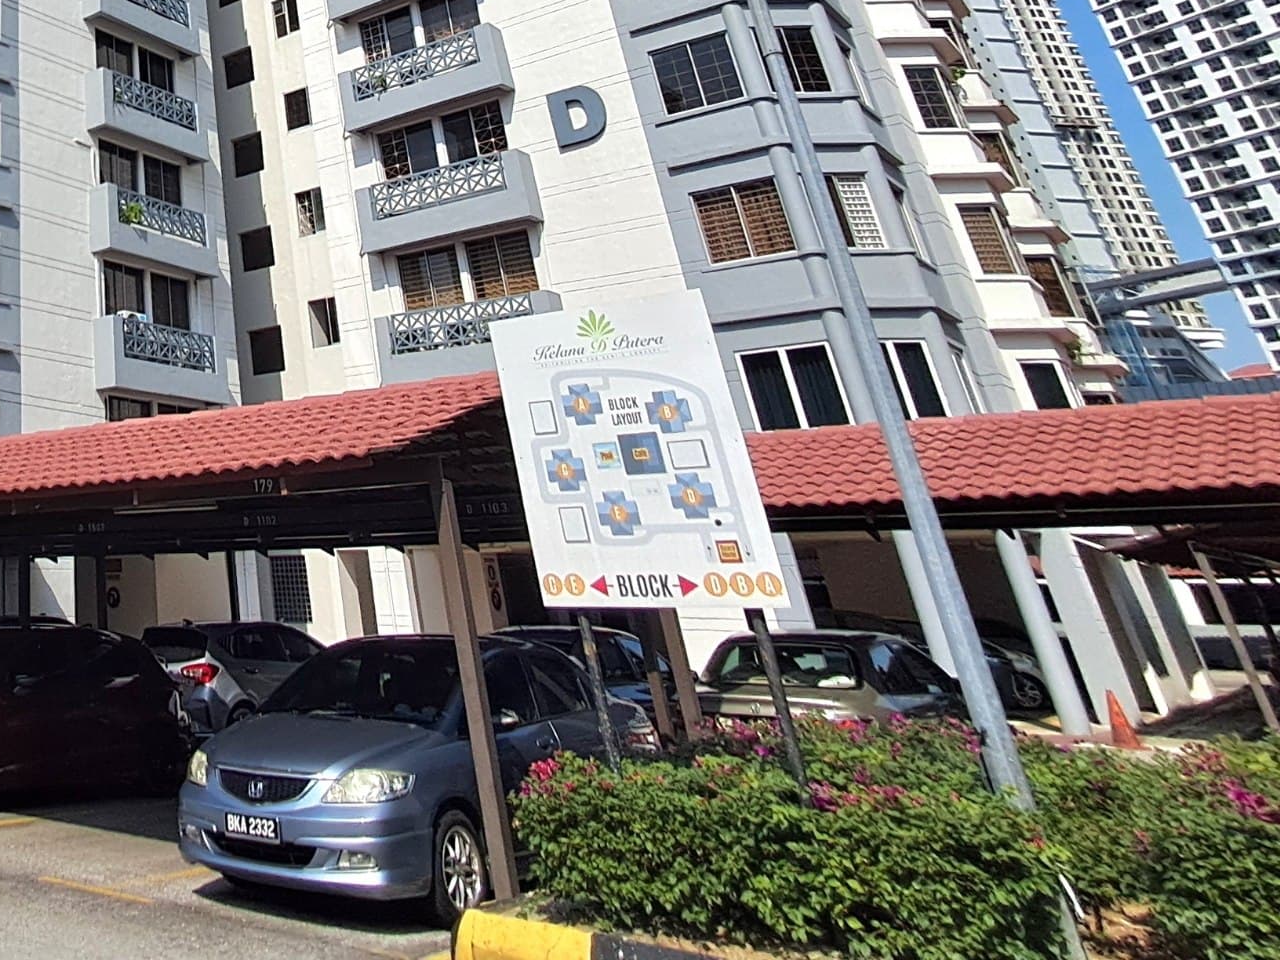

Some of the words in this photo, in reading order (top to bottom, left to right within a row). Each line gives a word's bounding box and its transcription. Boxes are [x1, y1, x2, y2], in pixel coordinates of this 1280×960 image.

[546, 85, 607, 153] D
[533, 344, 585, 361] Kelana
[612, 334, 663, 351] Putera
[608, 396, 639, 411] BLOCK
[611, 411, 643, 426] LAYOUT
[663, 405, 672, 419] B
[254, 478, 273, 493] 179
[481, 502, 508, 514] 1103
[570, 576, 579, 592] E
[616, 574, 673, 598] BLOCK
[711, 575, 722, 593] D
[736, 575, 750, 593] B
[764, 576, 778, 594] A
[227, 813, 247, 833] BKA
[248, 817, 275, 838] 2332
